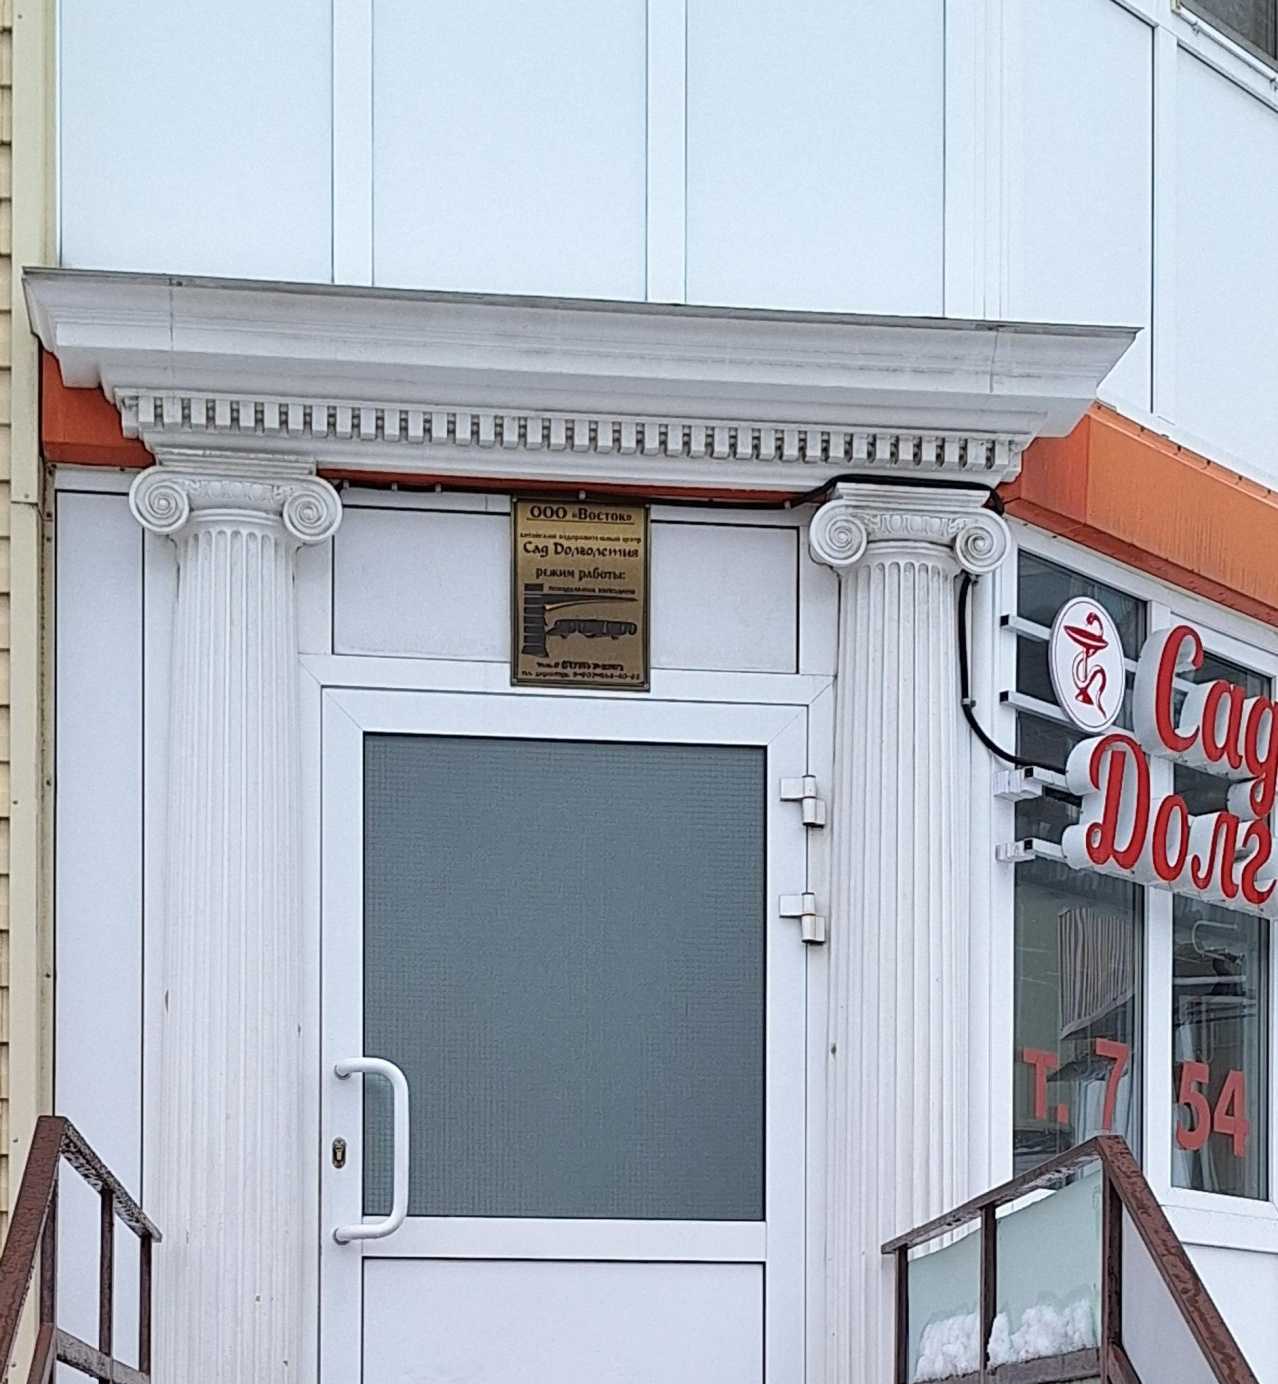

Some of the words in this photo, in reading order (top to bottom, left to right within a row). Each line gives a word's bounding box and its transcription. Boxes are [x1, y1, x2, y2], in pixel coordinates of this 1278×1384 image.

[530, 505, 568, 519] ООО
[523, 541, 549, 558] Сад
[553, 542, 640, 558] Долголетия
[535, 567, 575, 580] режим
[578, 567, 627, 582] работы:
[1155, 625, 1278, 817] Сад
